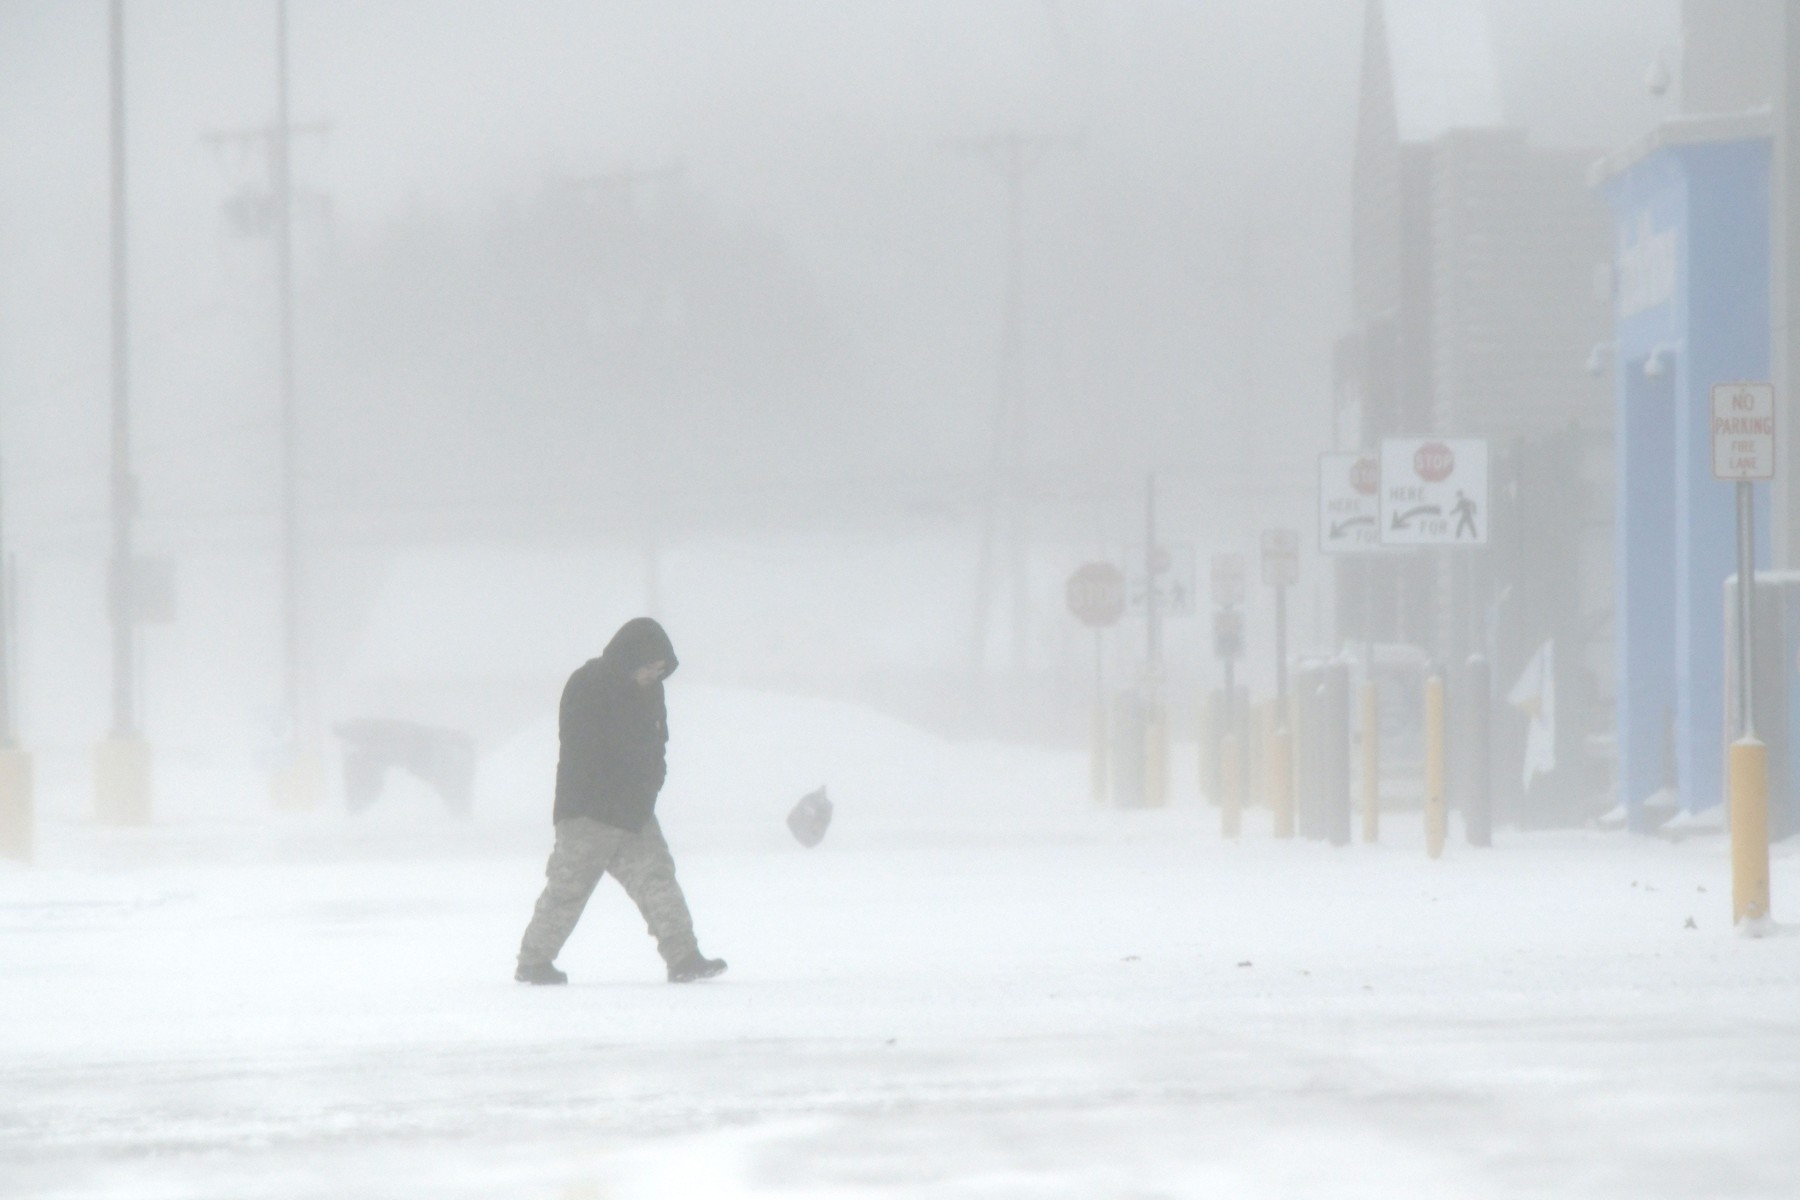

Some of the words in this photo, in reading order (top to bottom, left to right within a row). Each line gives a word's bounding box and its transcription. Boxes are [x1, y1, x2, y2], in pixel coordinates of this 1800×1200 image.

[1732, 394, 1754, 411] NO
[1715, 416, 1772, 434] PARKING
[1732, 441, 1755, 452] FIRE
[1415, 452, 1454, 472] STOP
[1350, 470, 1377, 487] STO
[1390, 486, 1424, 501] HERE
[1357, 529, 1377, 542] FO
[1420, 520, 1447, 534] FOR
[1068, 583, 1124, 607] STOP
